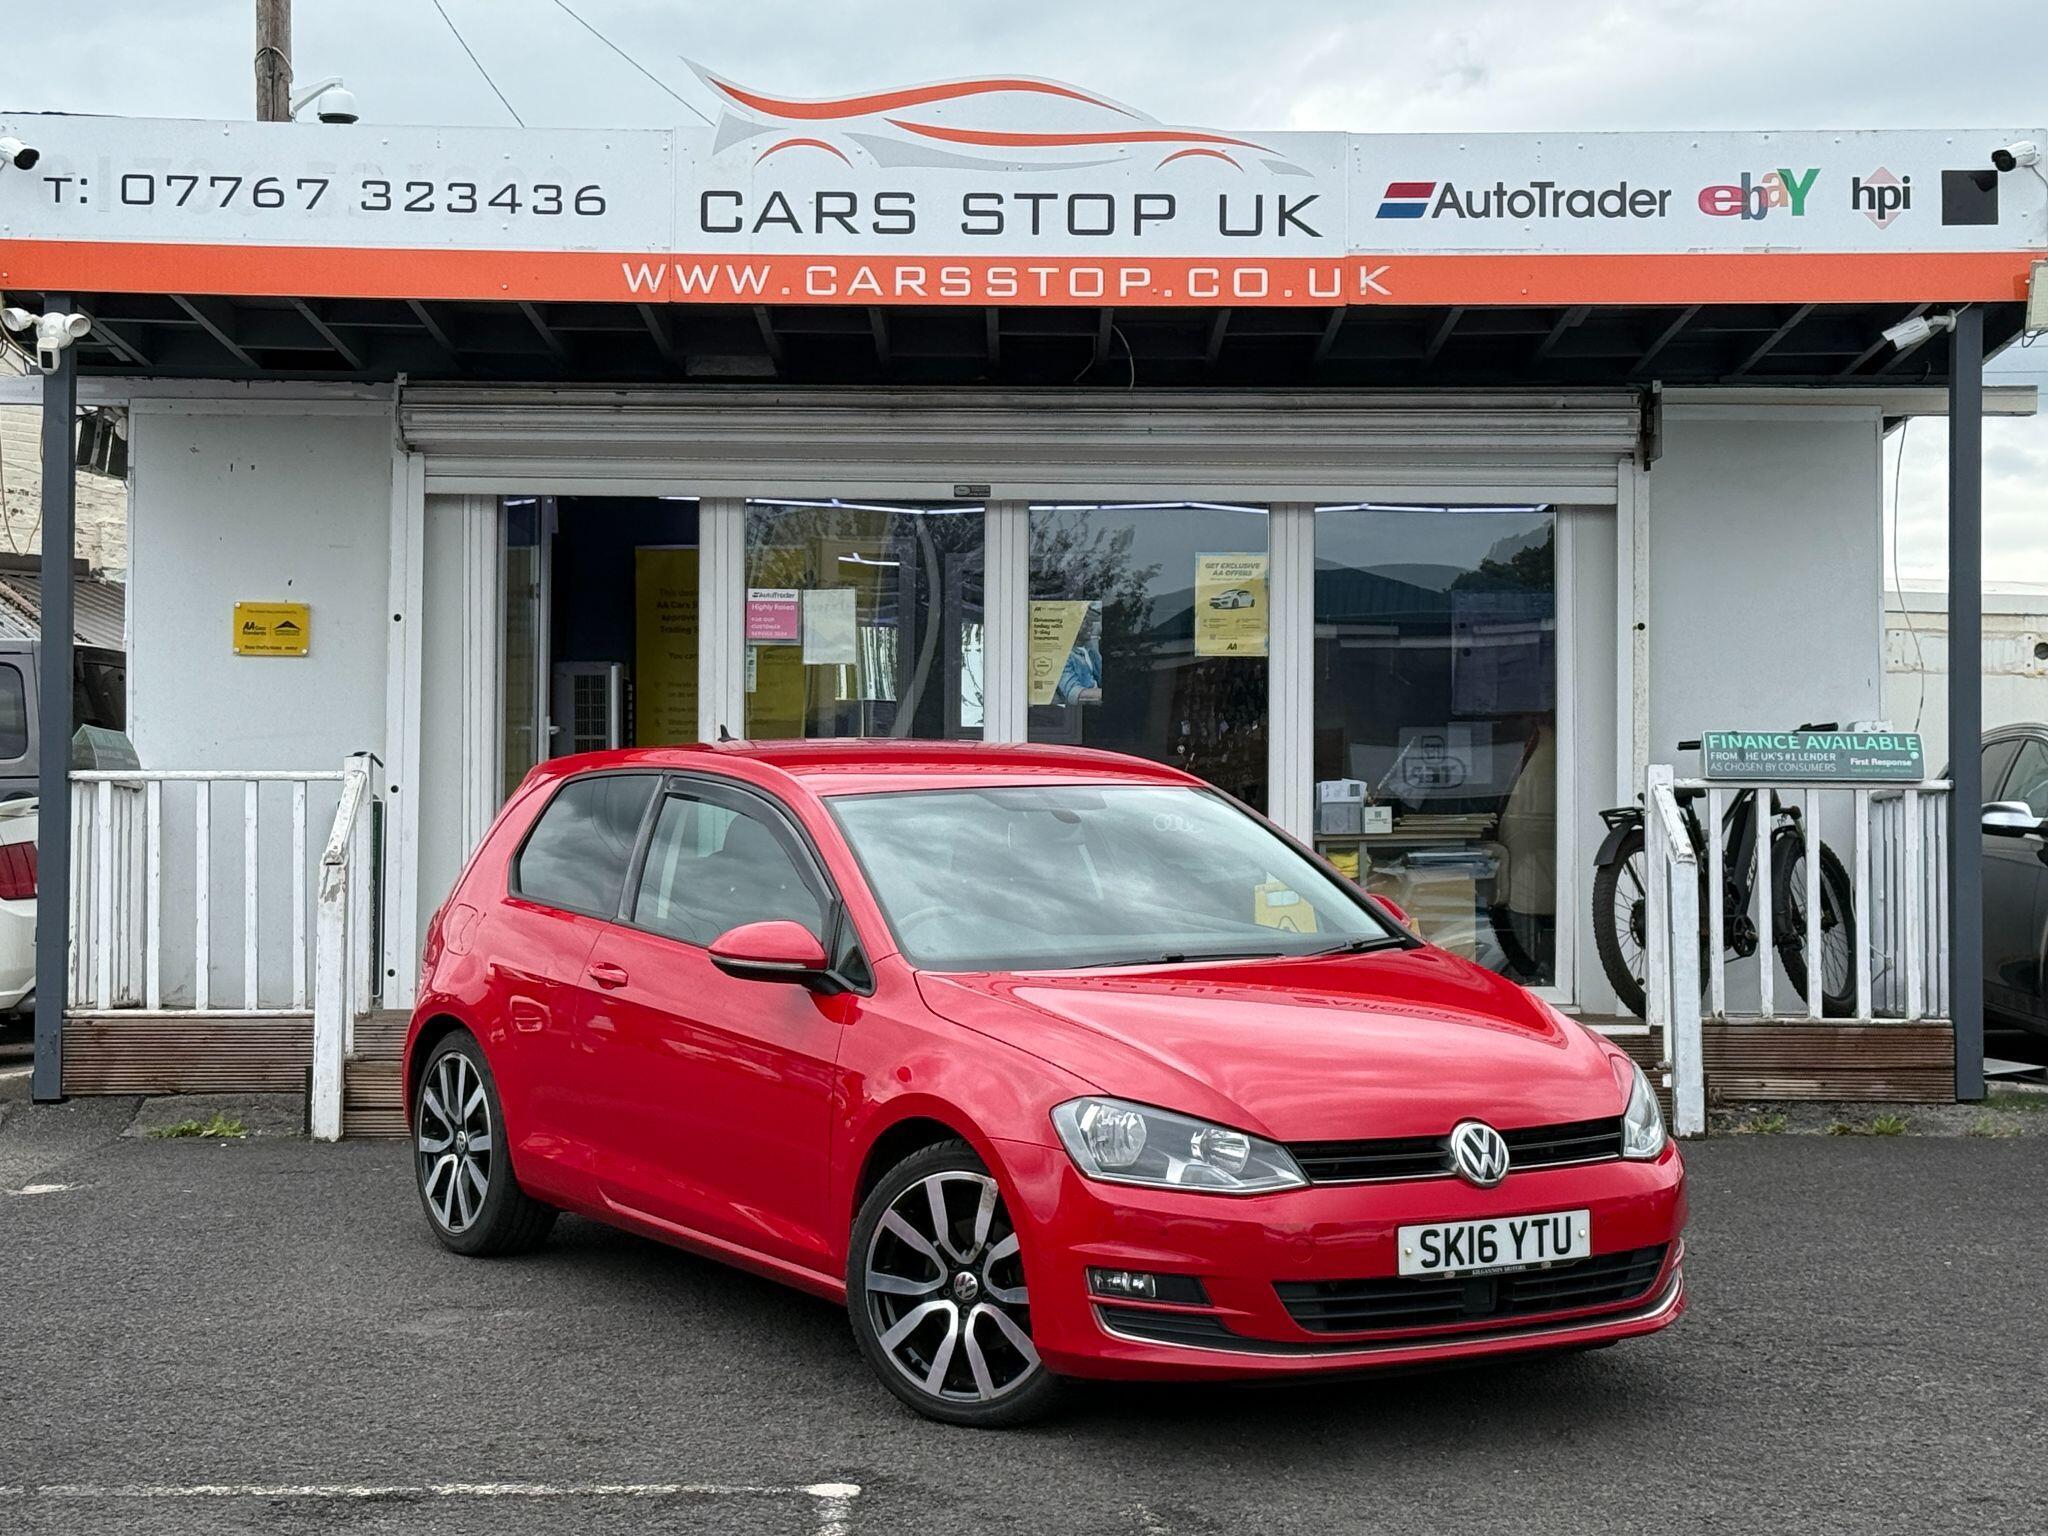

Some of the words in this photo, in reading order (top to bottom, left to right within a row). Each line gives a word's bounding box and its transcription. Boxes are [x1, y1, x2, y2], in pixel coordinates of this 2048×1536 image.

[121, 174, 330, 210] 07767
[361, 180, 608, 216] 323436
[1431, 180, 1672, 218] AutoTrader
[1851, 176, 1911, 225] hpi
[700, 190, 916, 235] CARS
[961, 192, 1176, 237] STOP
[1218, 194, 1323, 238] UK
[622, 262, 1393, 299] WWW.CARSSTOP.CO.UK
[1708, 734, 1800, 750] FINANCE
[1805, 735, 1919, 752] AVAILABLE
[1710, 752, 1738, 761] FROM
[1761, 752, 1784, 762] UK'S
[1799, 752, 1837, 762] LENDER
[1710, 762, 1723, 772] AS
[1724, 762, 1763, 772] CHOSEN
[1765, 763, 1776, 772] BY
[1778, 762, 1837, 773] CONSUMERS
[1851, 757, 1870, 767] First
[1872, 758, 1913, 769] Response
[1420, 1224, 1498, 1269] SK16
[1508, 1216, 1572, 1260] YTU
